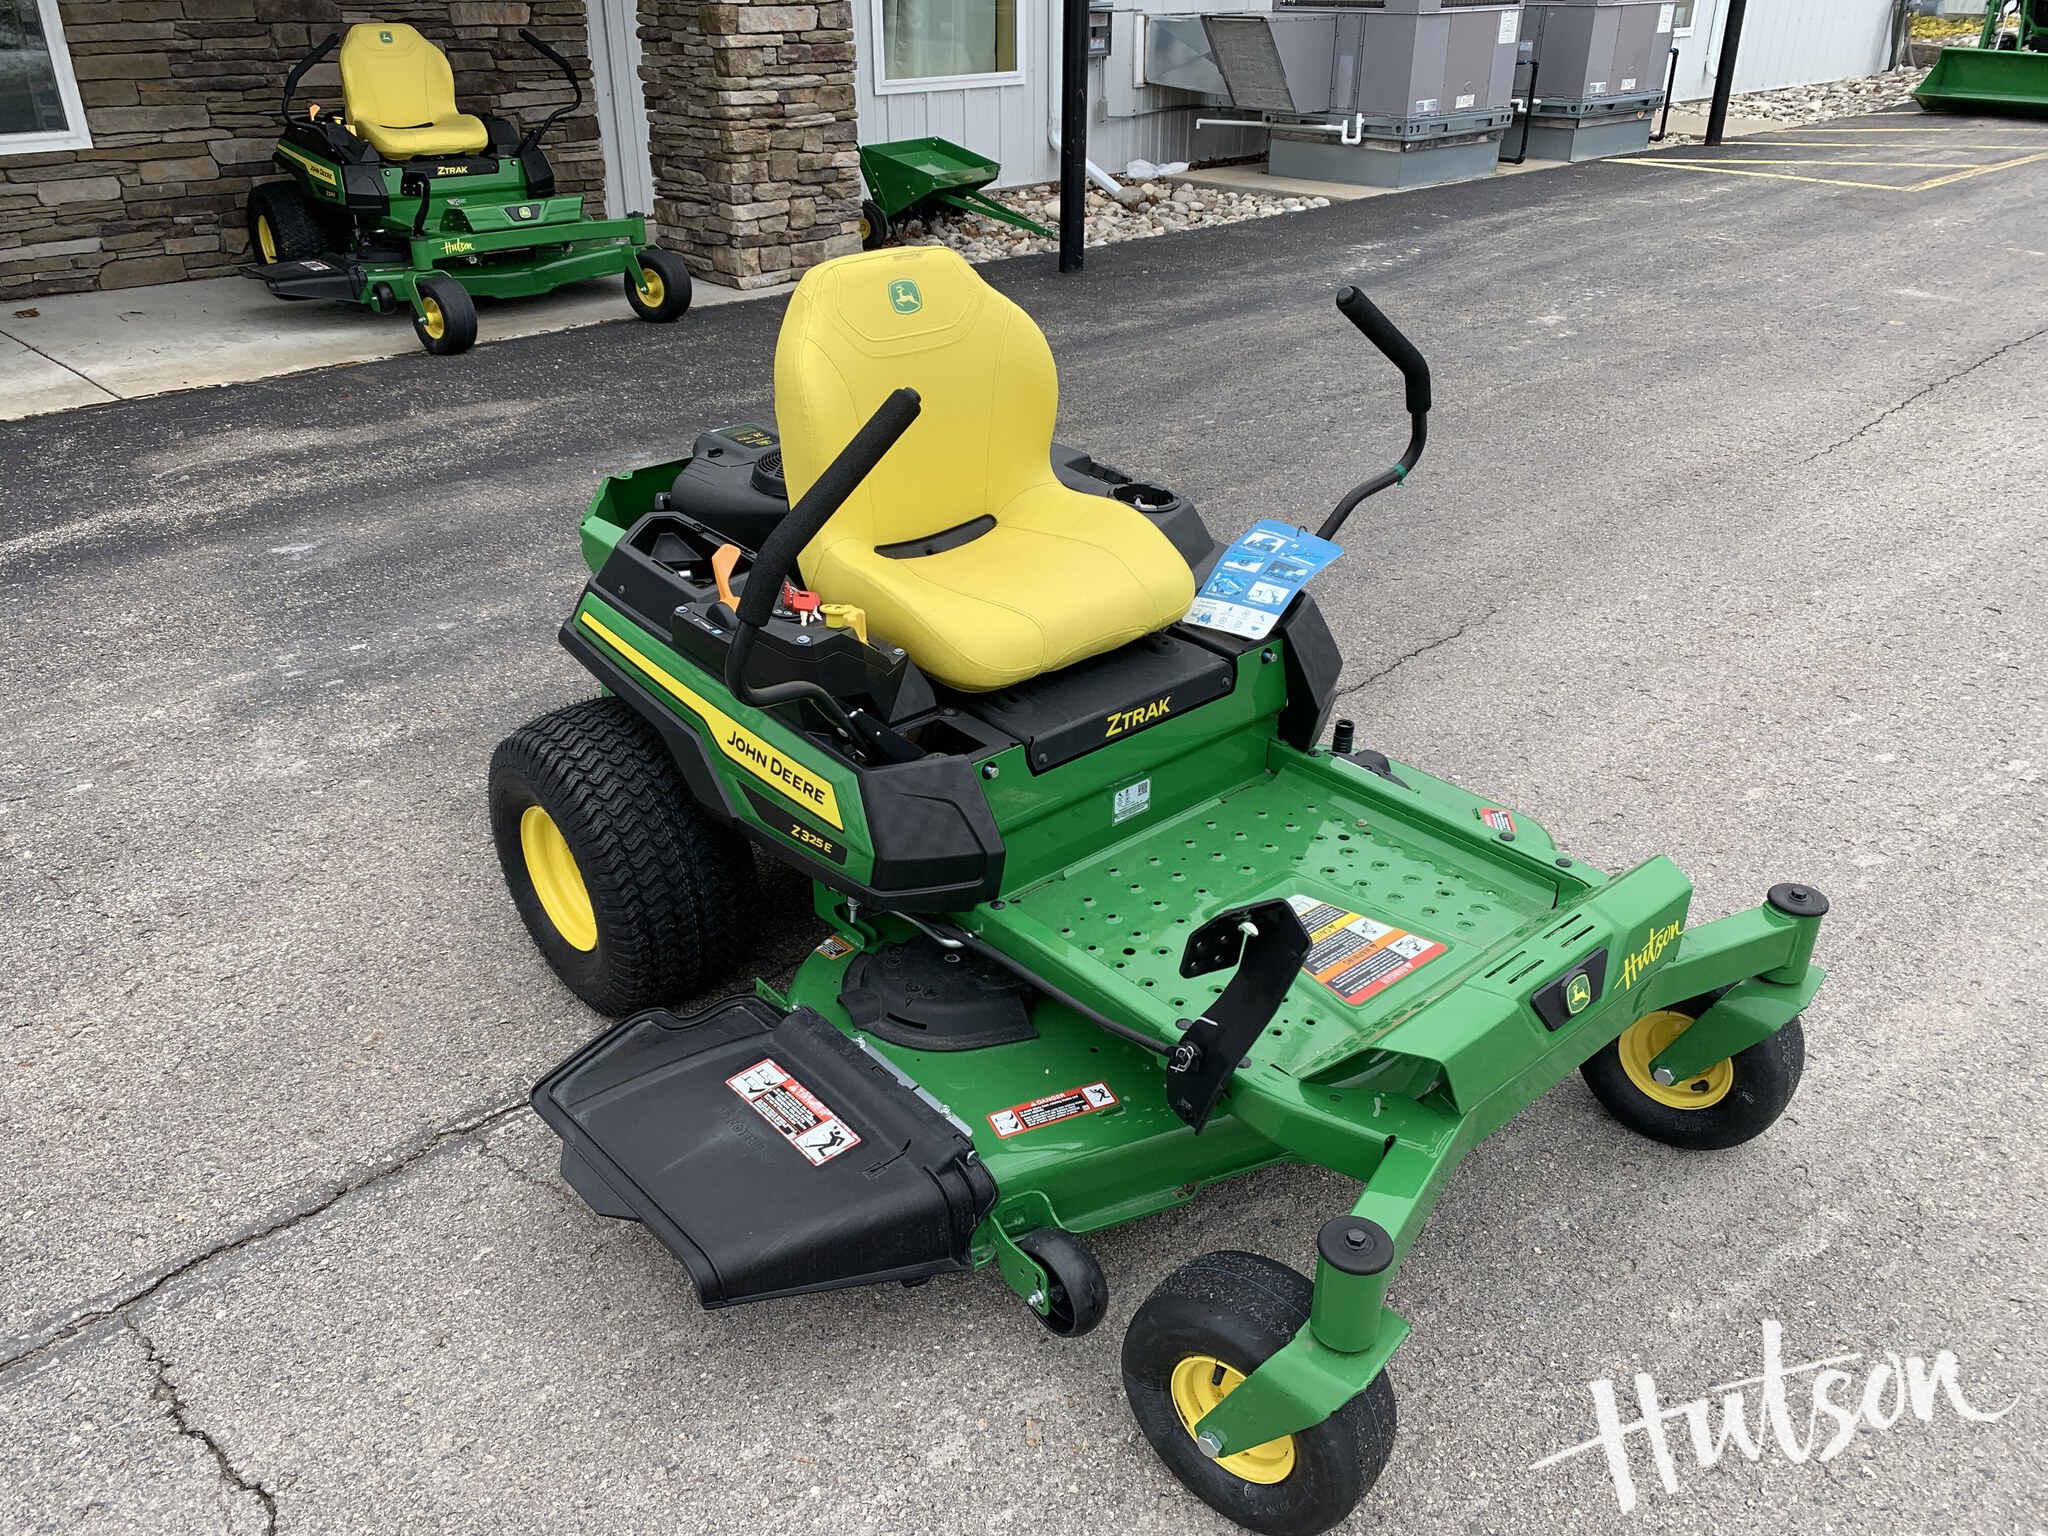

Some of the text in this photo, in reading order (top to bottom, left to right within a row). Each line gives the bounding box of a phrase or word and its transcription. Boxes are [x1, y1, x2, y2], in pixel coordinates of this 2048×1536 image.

[437, 166, 468, 175] ZTRAK
[440, 238, 476, 255] Hutson
[1105, 695, 1171, 738] ZTRAK
[727, 731, 826, 805] JOHN DEERE
[1613, 920, 1685, 991] Hutson
[796, 1087, 829, 1117] DANGER
[1036, 1093, 1066, 1105] DANGER
